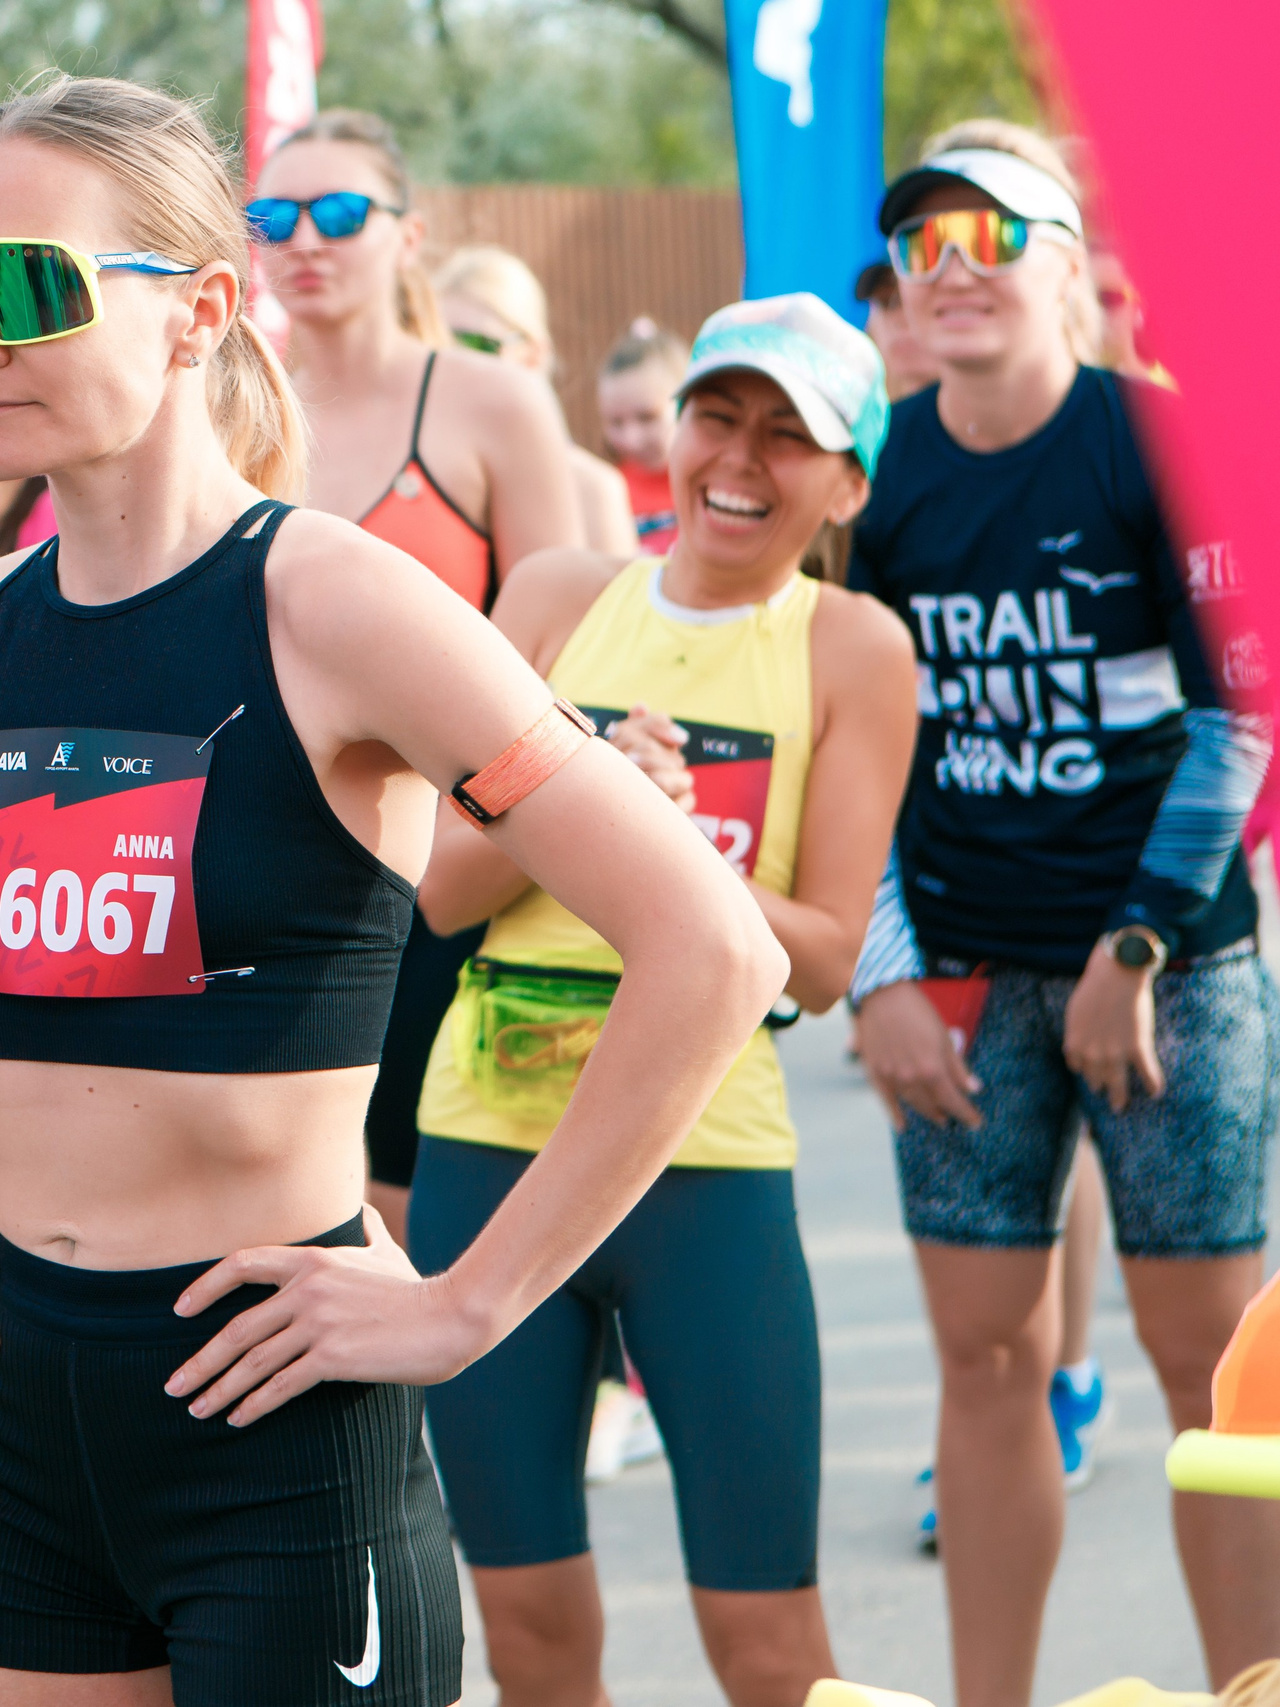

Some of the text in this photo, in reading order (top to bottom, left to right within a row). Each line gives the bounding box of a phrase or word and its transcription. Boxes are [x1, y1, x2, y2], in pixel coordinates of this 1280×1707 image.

[909, 588, 1097, 659] TRAIL
[103, 757, 153, 775] VOICE
[113, 834, 174, 860] ANNA
